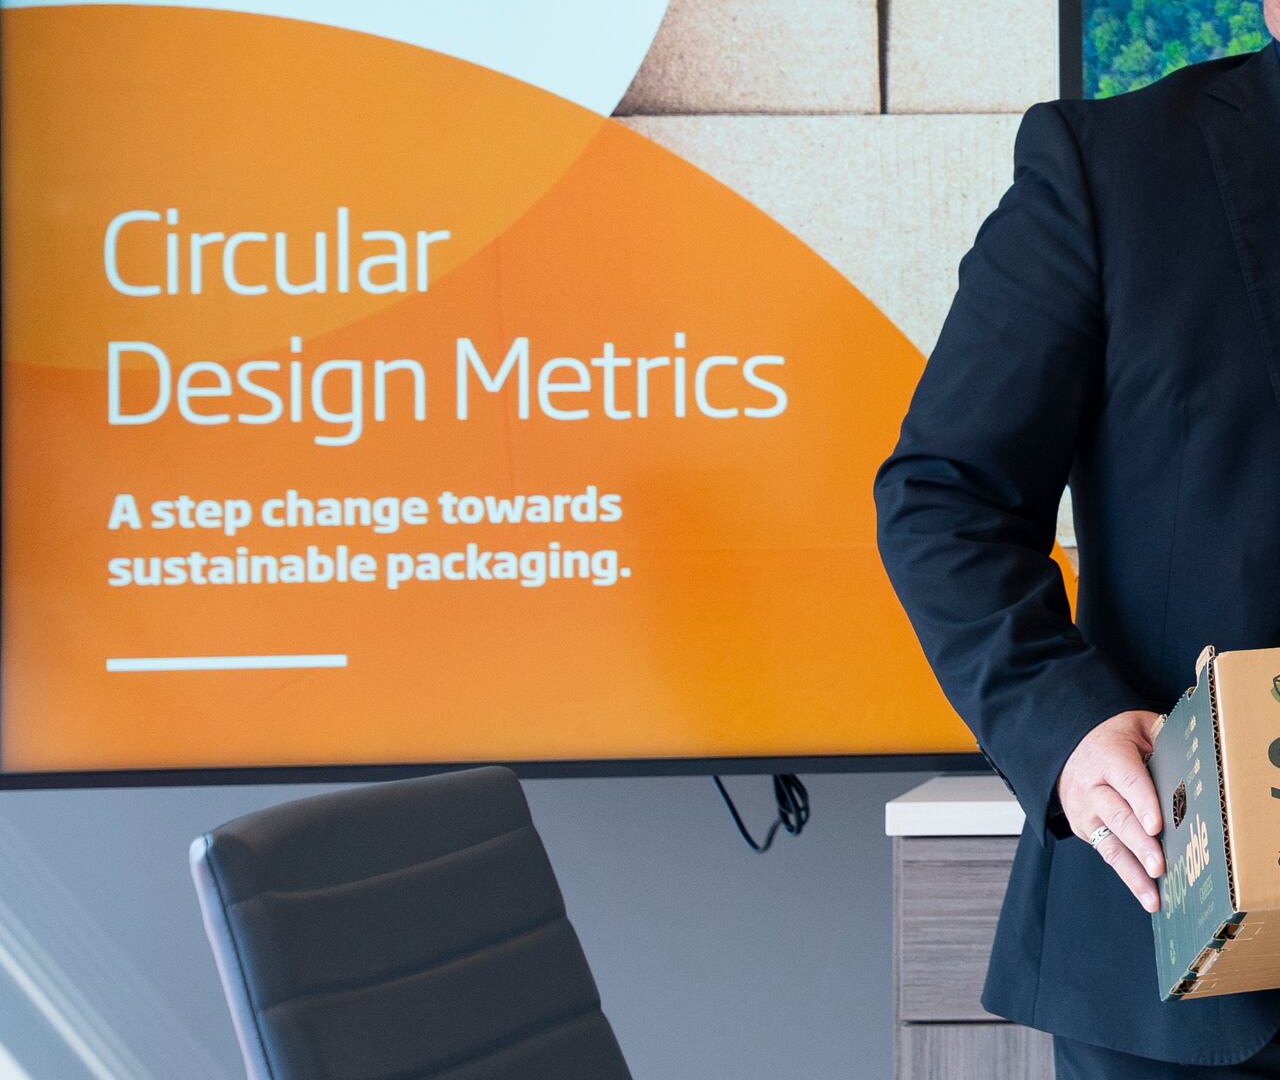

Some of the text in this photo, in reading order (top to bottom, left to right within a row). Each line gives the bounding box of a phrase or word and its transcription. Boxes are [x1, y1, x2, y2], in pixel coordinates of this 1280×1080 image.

[104, 207, 450, 297] Circular
[107, 332, 788, 447] Design Metrics
[107, 486, 624, 536] A step change towards
[107, 542, 632, 590] sustainable packaging.
